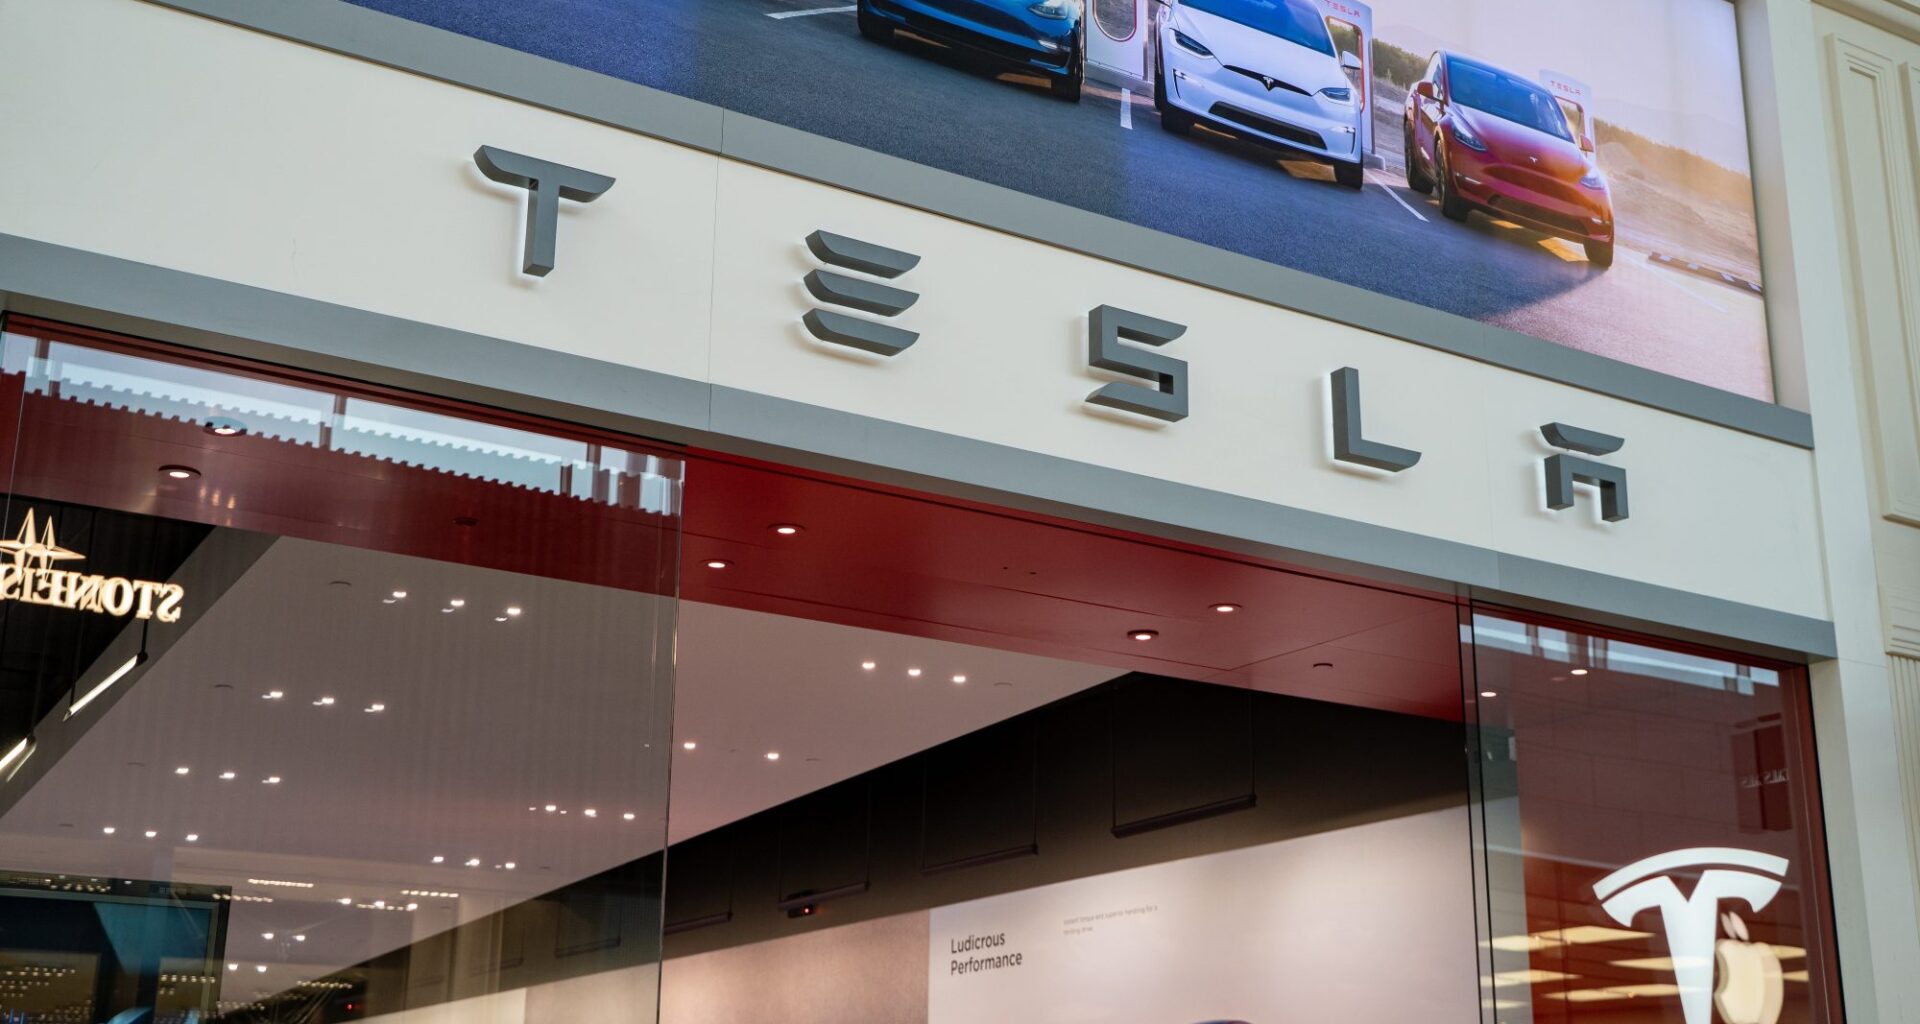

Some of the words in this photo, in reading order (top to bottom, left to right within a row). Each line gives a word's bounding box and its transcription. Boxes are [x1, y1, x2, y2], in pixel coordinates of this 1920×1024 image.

[473, 145, 1629, 523] TESLA
[951, 932, 1005, 954] Ludicrous
[951, 952, 1023, 976] Performance
